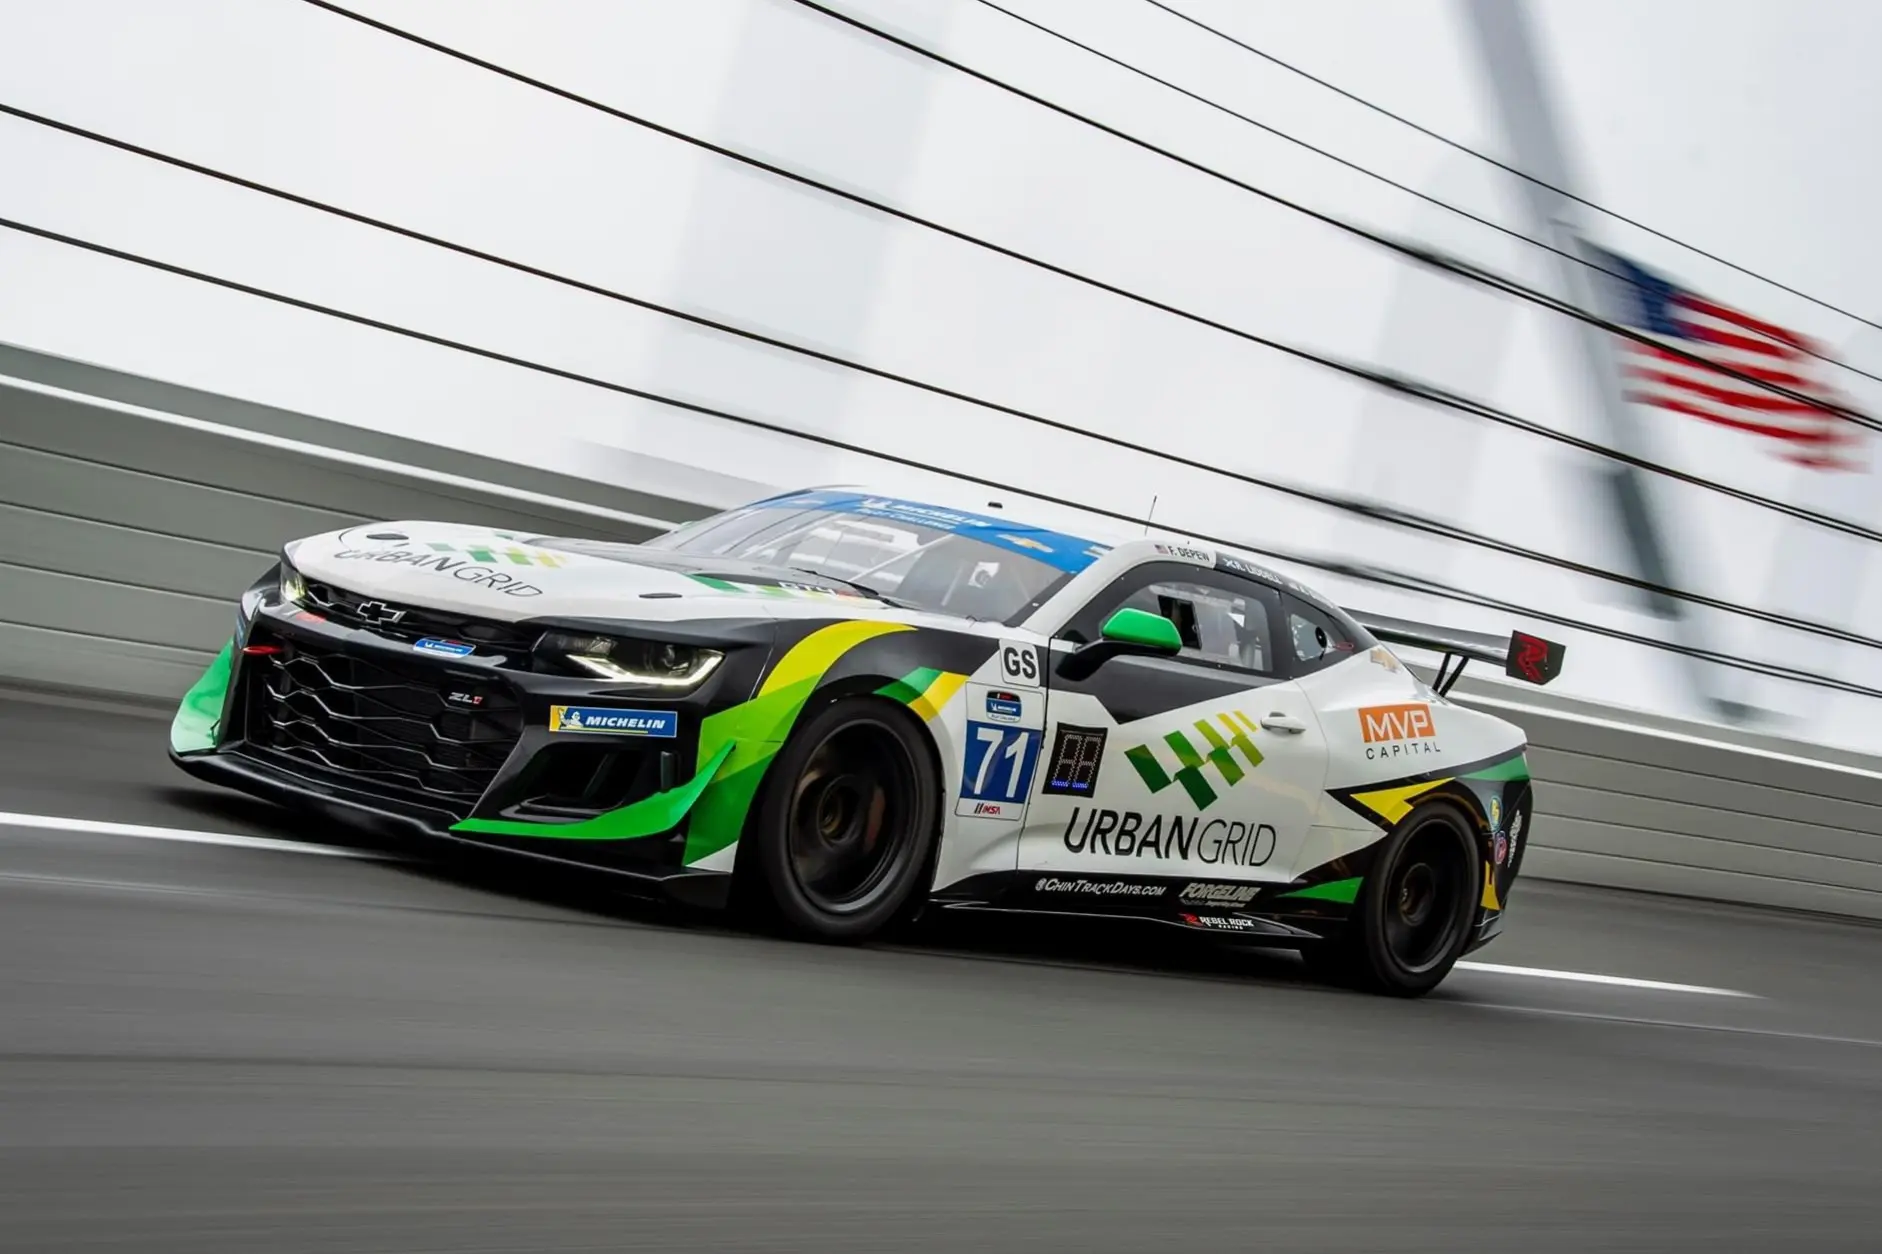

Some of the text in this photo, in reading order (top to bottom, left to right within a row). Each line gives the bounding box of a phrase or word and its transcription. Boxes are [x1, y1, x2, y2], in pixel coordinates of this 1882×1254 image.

[1003, 646, 1037, 680] GS
[448, 691, 483, 705] ZL1
[585, 715, 666, 730] MICHELIN
[1365, 710, 1429, 743] MVP
[1365, 741, 1441, 760] CAPITAL
[973, 727, 1030, 799] 71
[1199, 916, 1255, 927] REBEL ROCK
